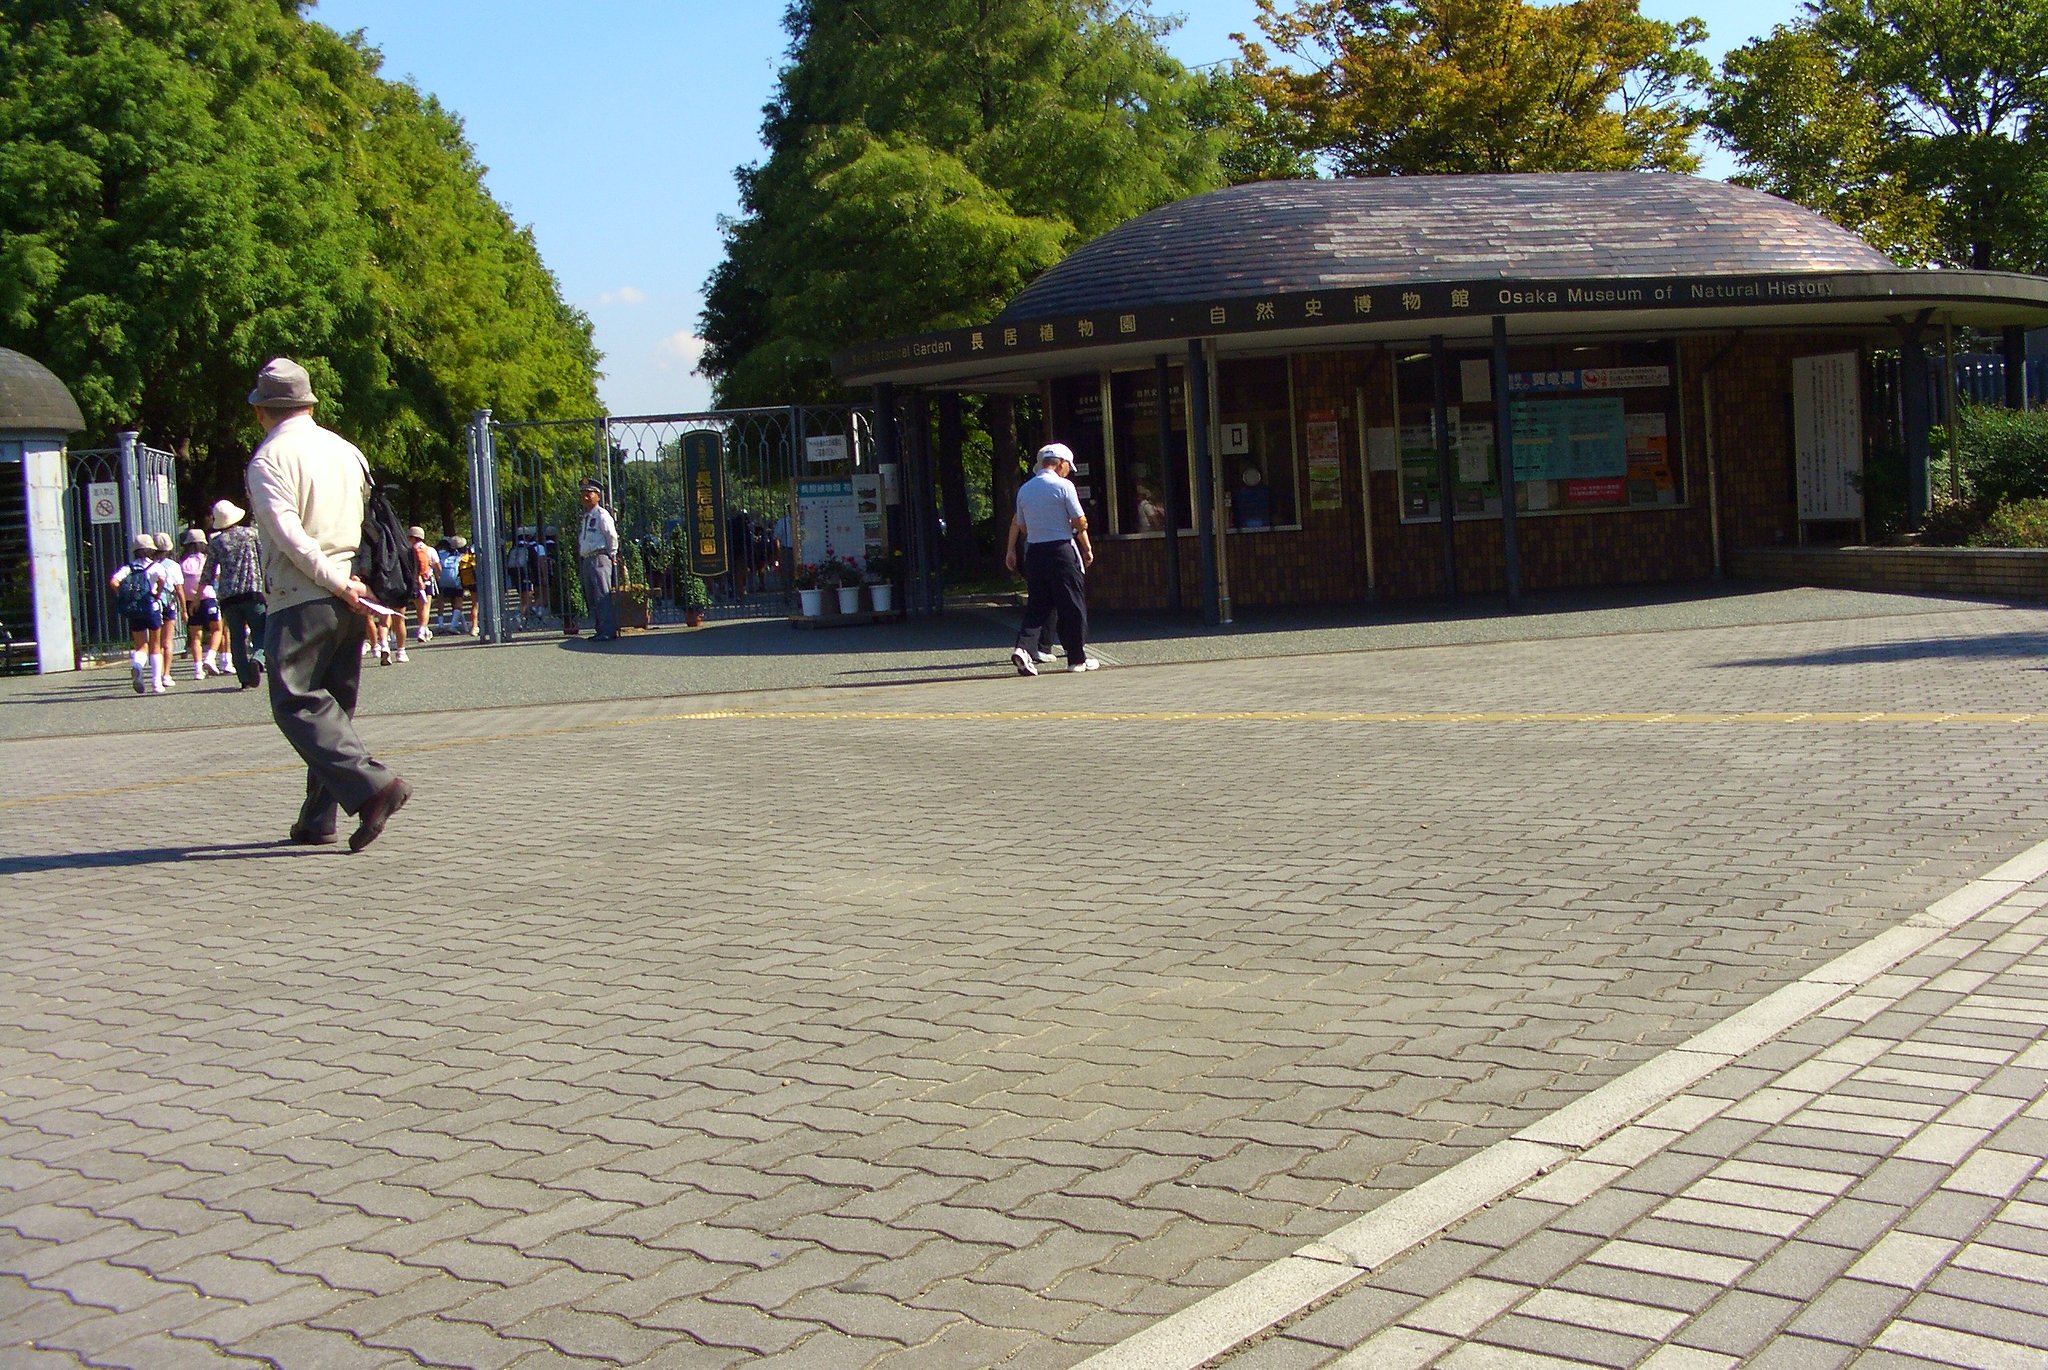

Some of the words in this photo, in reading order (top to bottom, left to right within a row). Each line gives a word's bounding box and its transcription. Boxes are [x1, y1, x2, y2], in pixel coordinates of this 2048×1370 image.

[1498, 289, 1558, 306] Osaka
[1567, 288, 1643, 304] Museum
[1653, 285, 1674, 301] of
[1690, 282, 1761, 300] Natural
[1767, 279, 1835, 298] History
[912, 339, 952, 357] Garden
